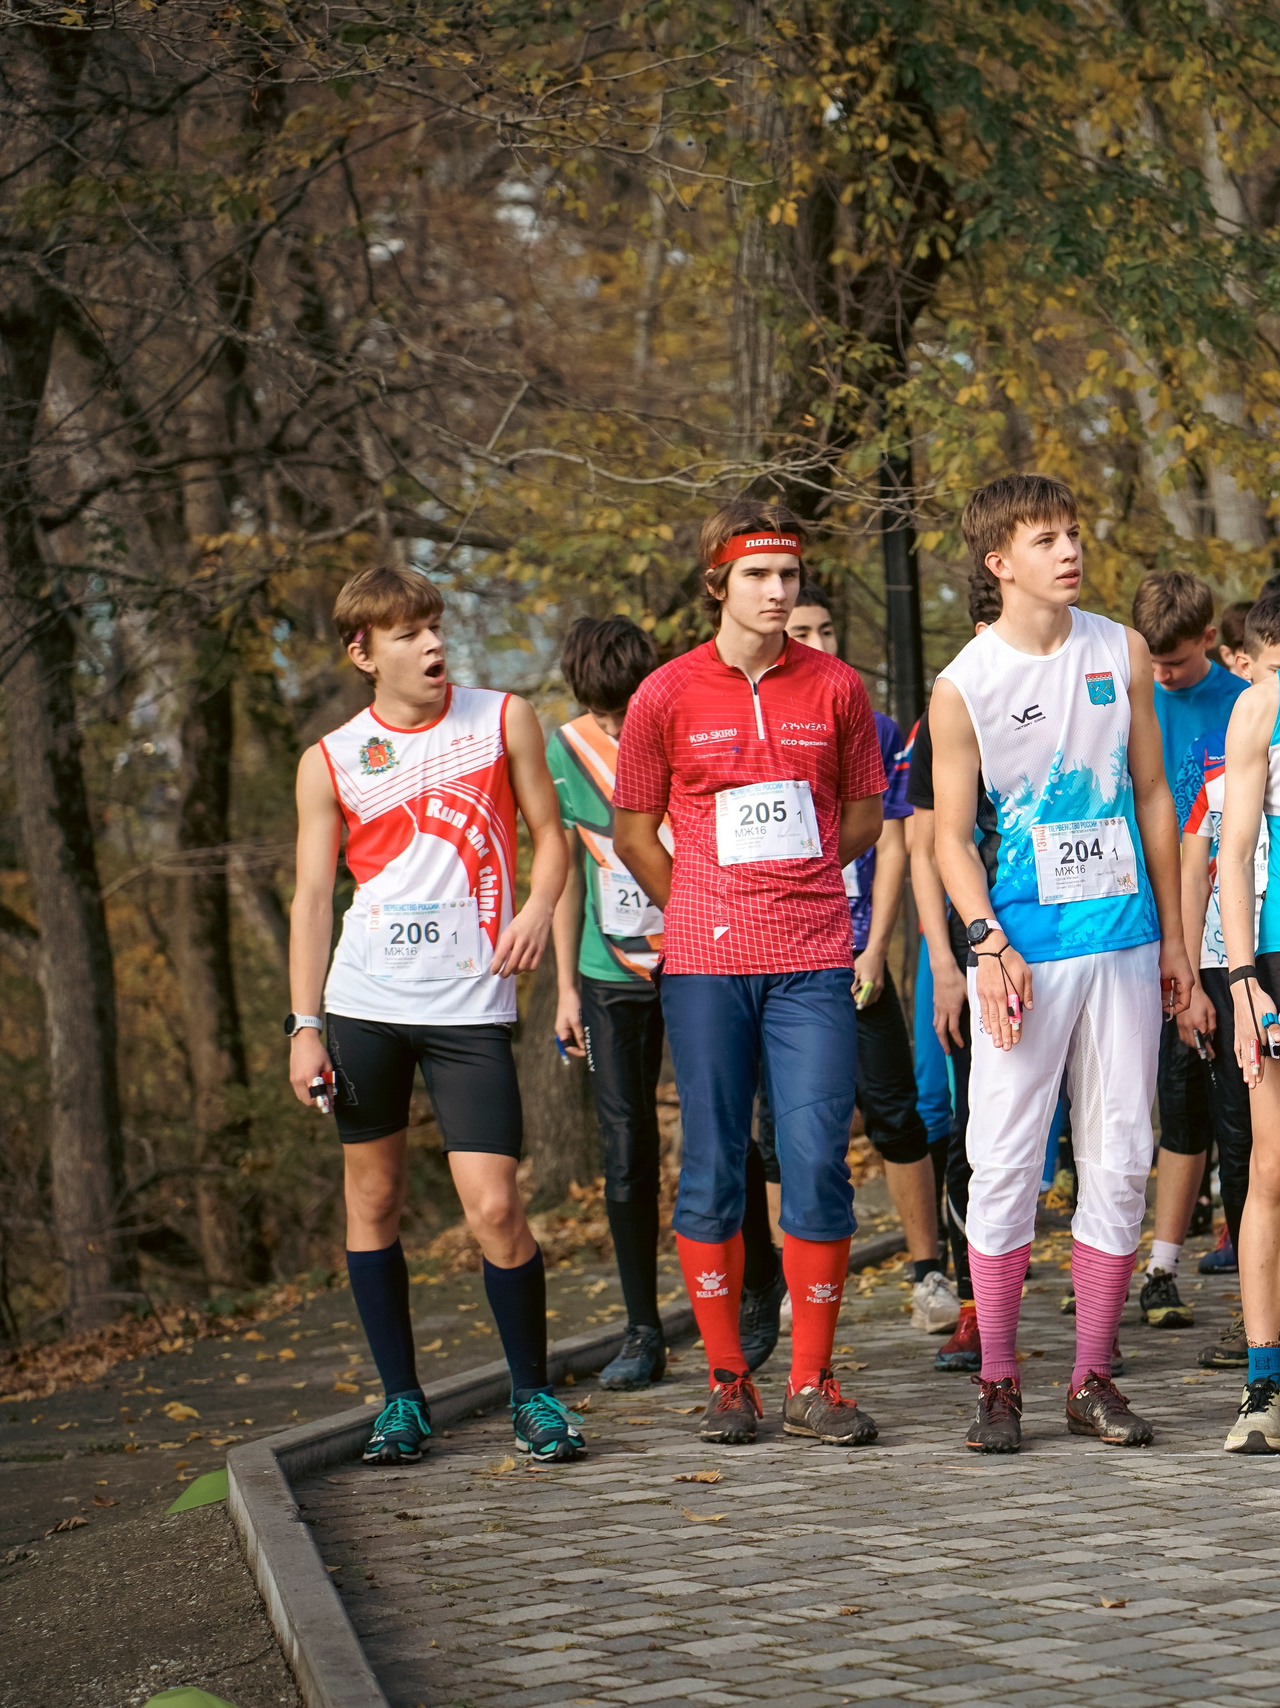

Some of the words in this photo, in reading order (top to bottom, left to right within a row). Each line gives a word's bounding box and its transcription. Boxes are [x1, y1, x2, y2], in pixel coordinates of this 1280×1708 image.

[745, 538, 797, 548] noname
[739, 800, 787, 826] 205
[796, 810, 802, 823] 1
[735, 826, 767, 838] МЖ16
[1048, 821, 1080, 833] ПЕРВЕНСТВО
[1080, 820, 1098, 829] РОССИИ
[1059, 838, 1104, 864] 204
[1112, 847, 1119, 860] 1
[425, 797, 468, 829] Run
[478, 866, 499, 928] think
[1055, 865, 1086, 876] МЖ16
[618, 888, 652, 908] 21
[390, 921, 441, 945] 206
[451, 930, 458, 945] 1
[384, 947, 418, 956] МЖ16
[696, 1287, 729, 1299] KELME
[806, 1294, 839, 1304] KELME
